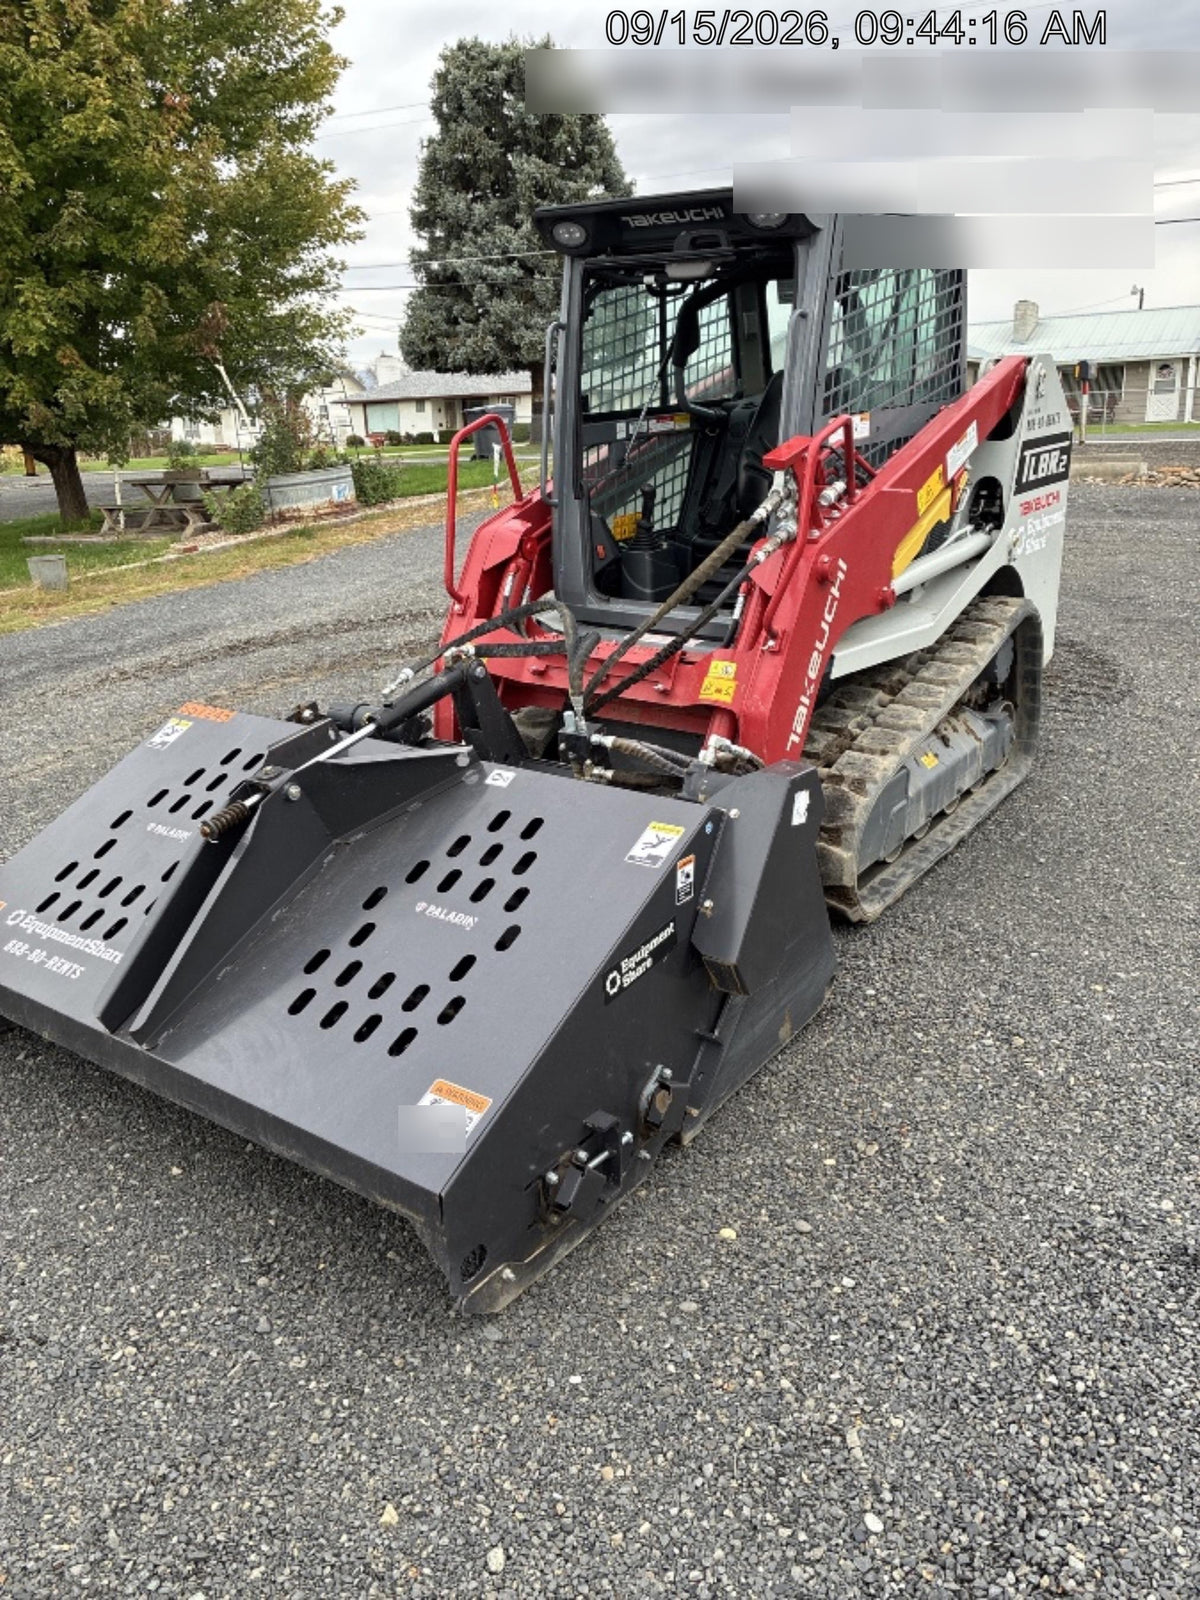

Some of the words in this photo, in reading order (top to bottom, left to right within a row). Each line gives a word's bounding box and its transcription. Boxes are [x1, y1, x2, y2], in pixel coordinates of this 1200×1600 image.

[621, 206, 725, 228] TAKEUCHI
[786, 557, 848, 752] TAKEUCHI
[425, 904, 475, 929] PALADIN
[621, 922, 675, 974] Equipment
[622, 957, 653, 987] Share
